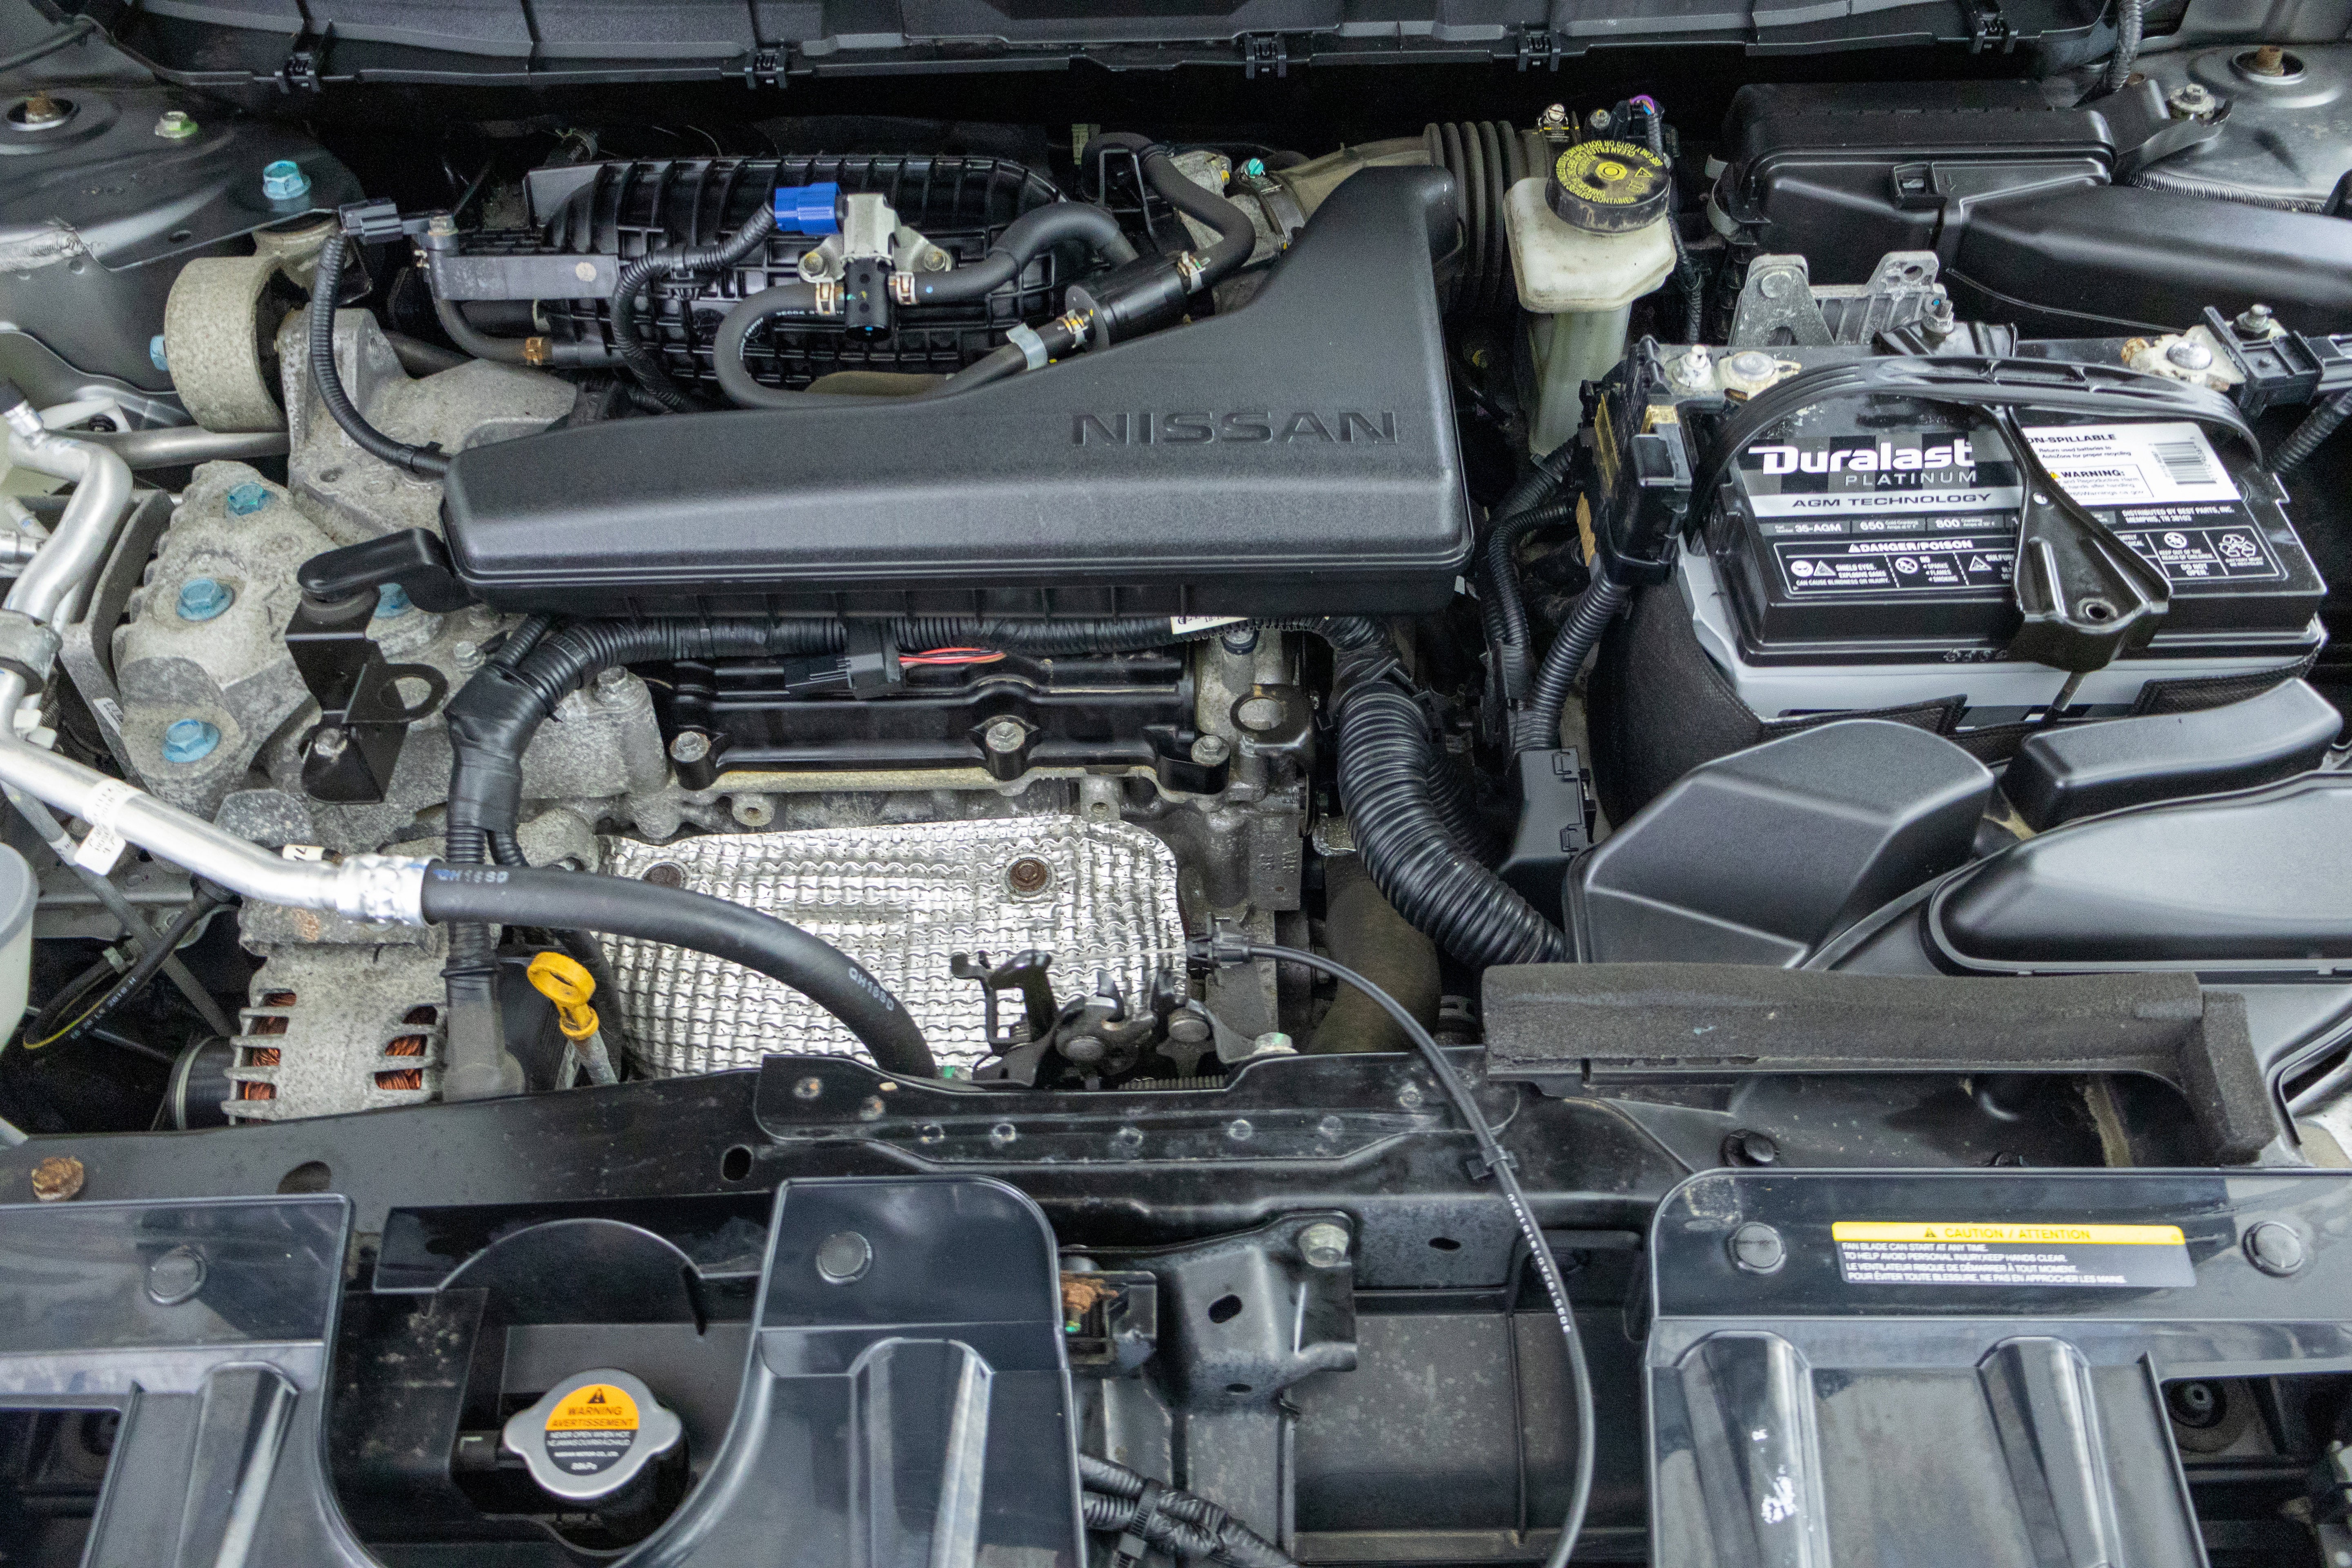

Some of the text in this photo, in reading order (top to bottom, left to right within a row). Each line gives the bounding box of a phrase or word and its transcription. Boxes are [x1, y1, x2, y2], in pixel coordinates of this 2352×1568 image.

[1586, 146, 1609, 155] FILLER
[1611, 146, 1635, 157] CLEAN
[1617, 142, 1636, 151] DOT3
[1566, 184, 1592, 200] SEALED
[1592, 196, 1636, 205] CONTAINER
[1071, 410, 1398, 445] NISSAN
[2026, 433, 2117, 444] ON-SPILLABLE
[1748, 438, 1976, 475] Duralast
[1846, 470, 1978, 487] PLATINUM
[2060, 470, 2125, 479] WARNING:
[1792, 493, 1991, 508] AGM TECHNOLOGY
[2122, 509, 2165, 517] DISTRIBUTED
[2196, 507, 2220, 515] PARTS,
[1935, 519, 1960, 528] 800
[2125, 516, 2161, 524] MEMPHIS,
[1795, 523, 1842, 533] 35-AGM
[1860, 521, 1884, 531] 650
[1859, 539, 1973, 553] DANGER/POISON
[1944, 1228, 2003, 1238] CAUTION
[2019, 1229, 2091, 1239] ATTENTION
[1842, 1242, 1859, 1250] FAN
[1860, 1242, 1888, 1251] BLADE
[1889, 1243, 1908, 1251] CAN
[1909, 1243, 1935, 1251] START
[1966, 1243, 1989, 1252] TIME.
[1858, 1252, 1880, 1260] HELP
[1880, 1252, 1907, 1260] AVOID
[1907, 1252, 1953, 1261] PERSONAL
[1858, 1263, 1912, 1271] VENTILATEUR
[1913, 1263, 1945, 1272] RISQUE
[1848, 1272, 1873, 1280] POUR
[1904, 1273, 1932, 1281] TOUTE
[2025, 1274, 2078, 1283] APPROCHER
[568, 1406, 622, 1415] WARNING
[552, 1418, 634, 1427] AVERTISSEMENT
